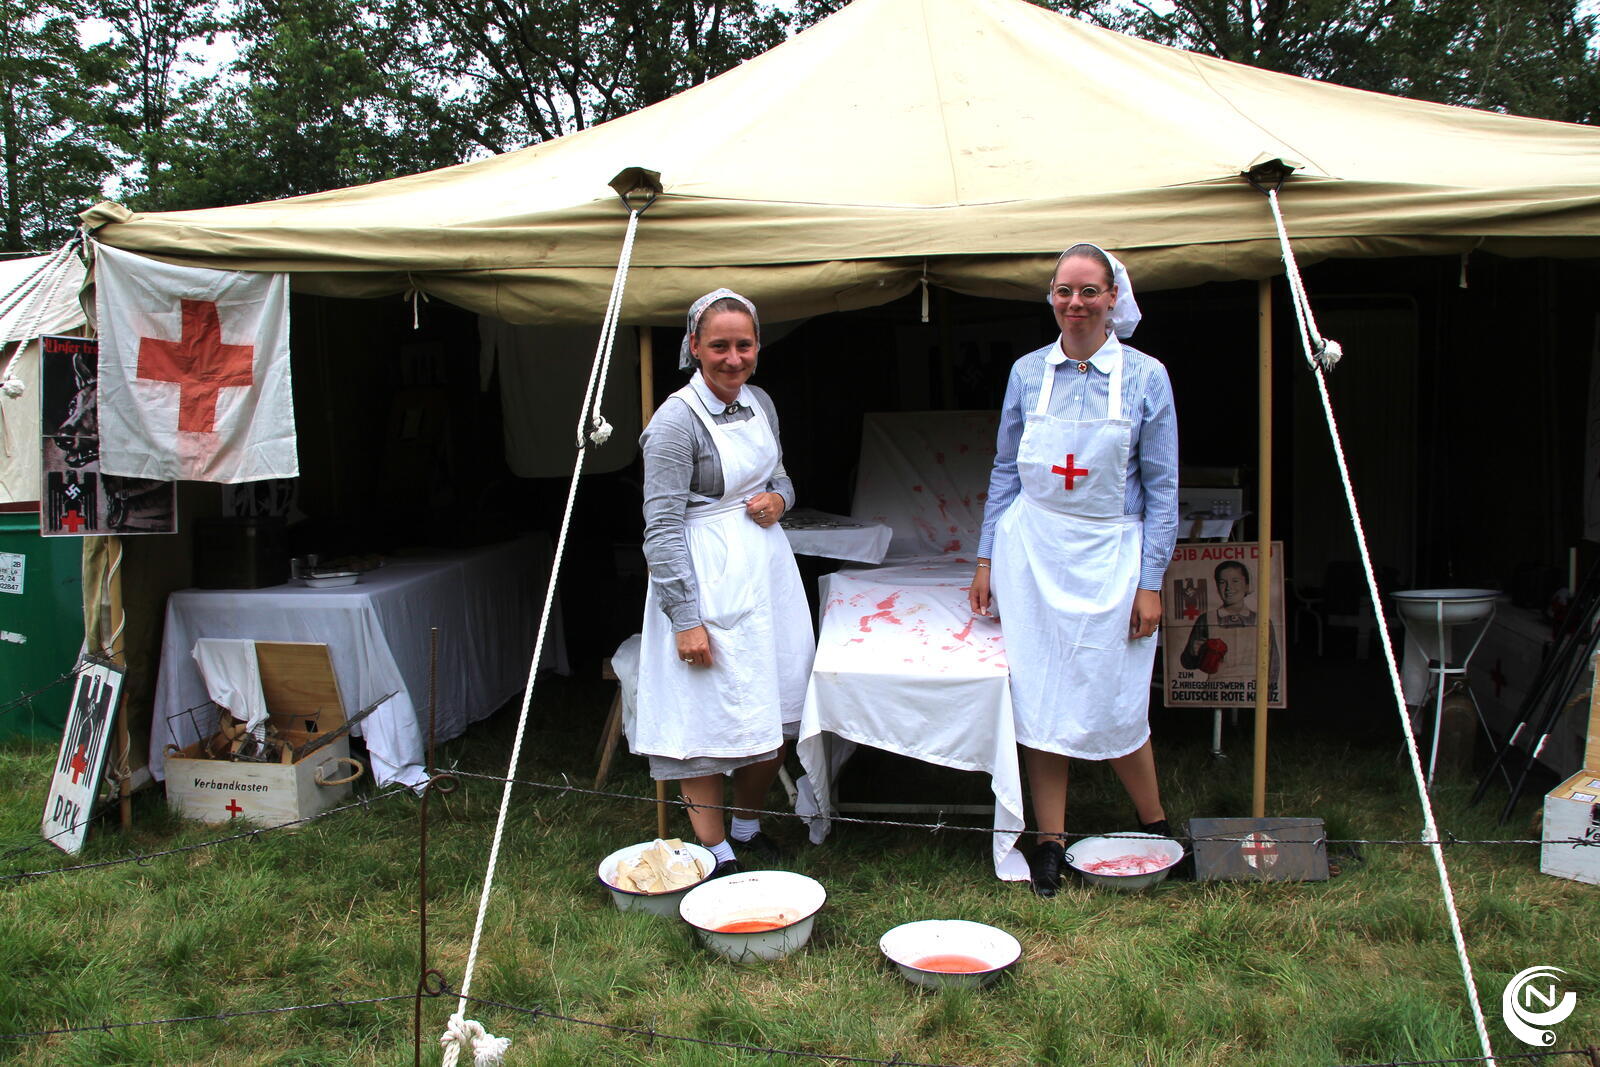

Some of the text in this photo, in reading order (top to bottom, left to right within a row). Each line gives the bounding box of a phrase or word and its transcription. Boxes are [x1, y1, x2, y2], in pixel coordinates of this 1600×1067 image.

[1172, 546, 1274, 561] GIB AUCH D
[1178, 671, 1194, 679] ZUM
[1172, 691, 1218, 701] DEUTSCHE
[1221, 692, 1245, 702] ROTE
[194, 778, 269, 793] Verbandkasten
[53, 794, 81, 835] DRK
